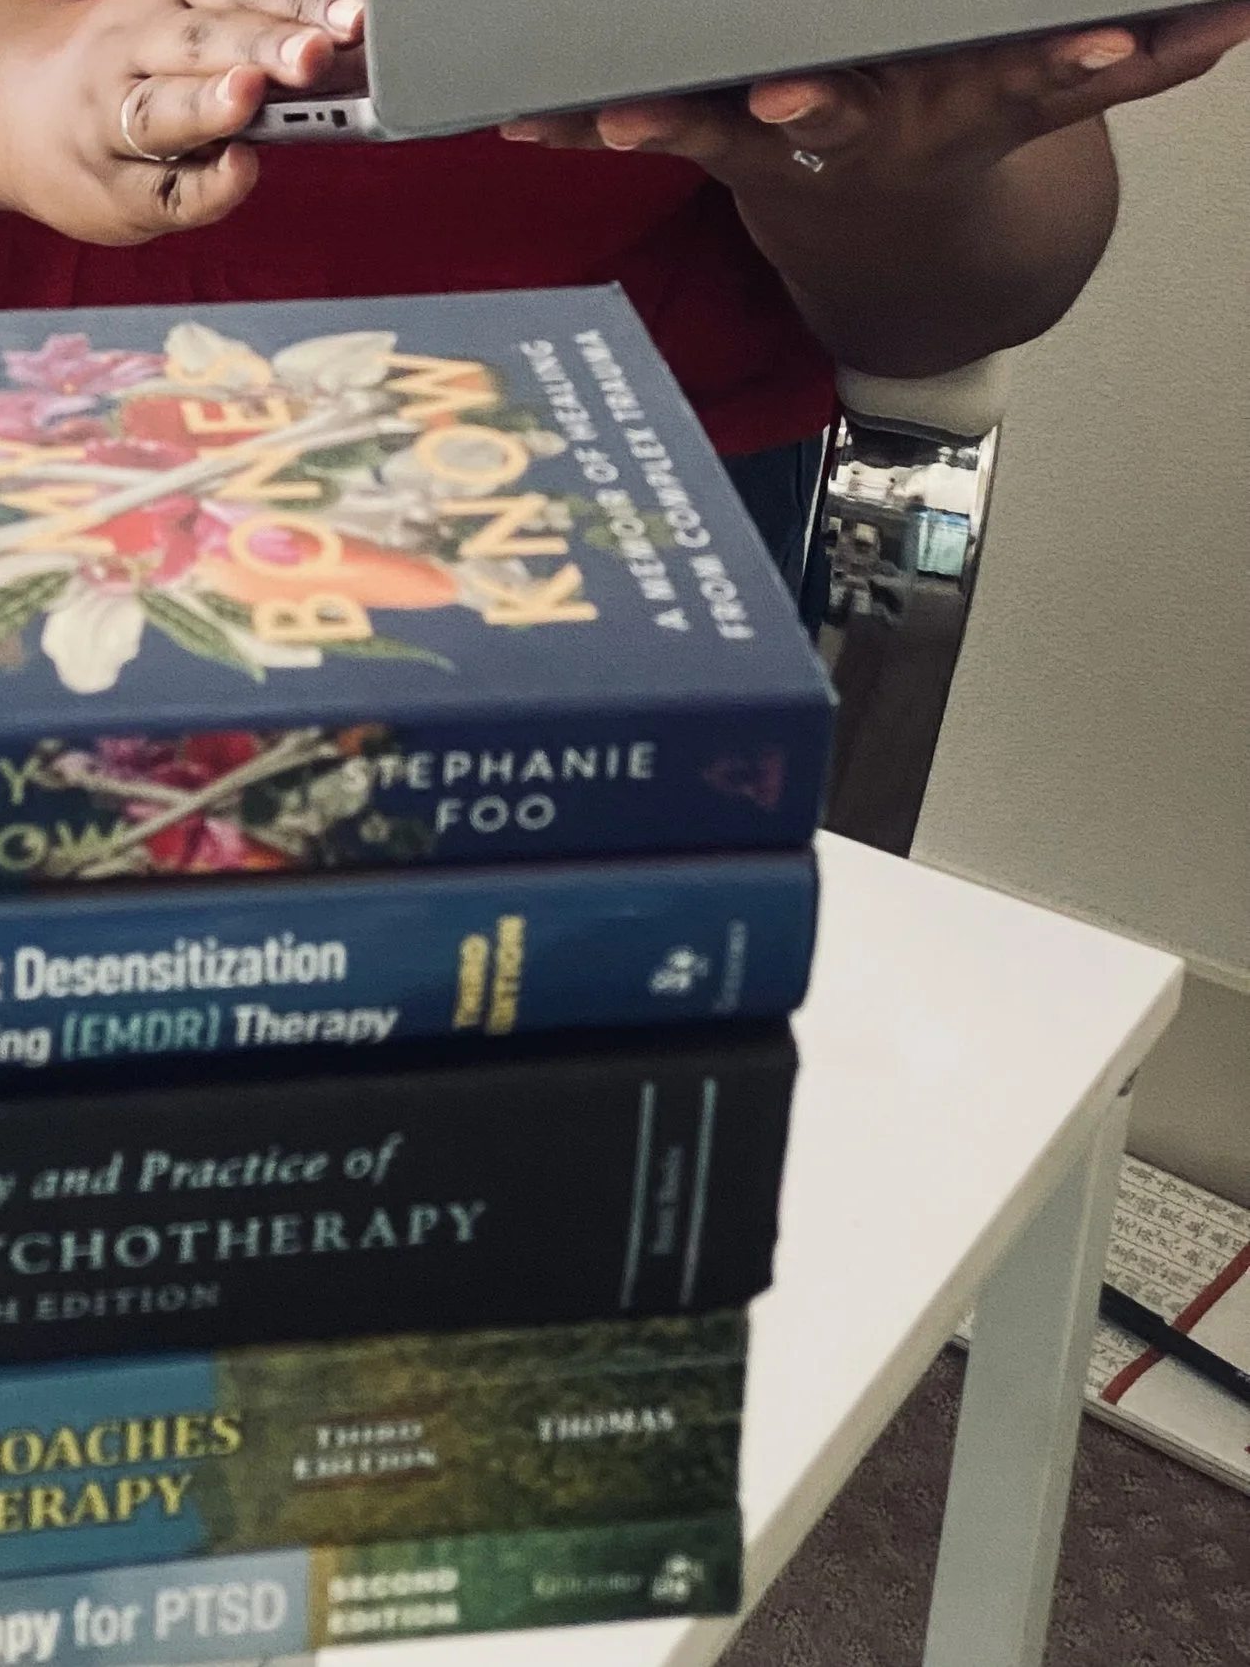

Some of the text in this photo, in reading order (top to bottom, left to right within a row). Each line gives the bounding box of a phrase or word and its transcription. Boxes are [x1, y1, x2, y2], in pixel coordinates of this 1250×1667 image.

[162, 344, 375, 644] BONES
[382, 350, 599, 628] KNOW
[517, 338, 691, 634] A MEMOIR OF HEALING
[573, 328, 755, 641] FROM COMPLEX TRAUMA
[344, 740, 659, 794] STEPHANIE
[434, 792, 557, 835] FOO
[14, 932, 348, 1002] Desensitization
[232, 1002, 401, 1050] Therapy
[31, 1150, 125, 1201] and
[136, 1142, 330, 1194] Practice
[344, 1131, 405, 1184] of
[34, 1280, 223, 1323] EDITION
[537, 1407, 678, 1443] THOMAS
[73, 1595, 144, 1649] for
[154, 1579, 289, 1642] PTSD
